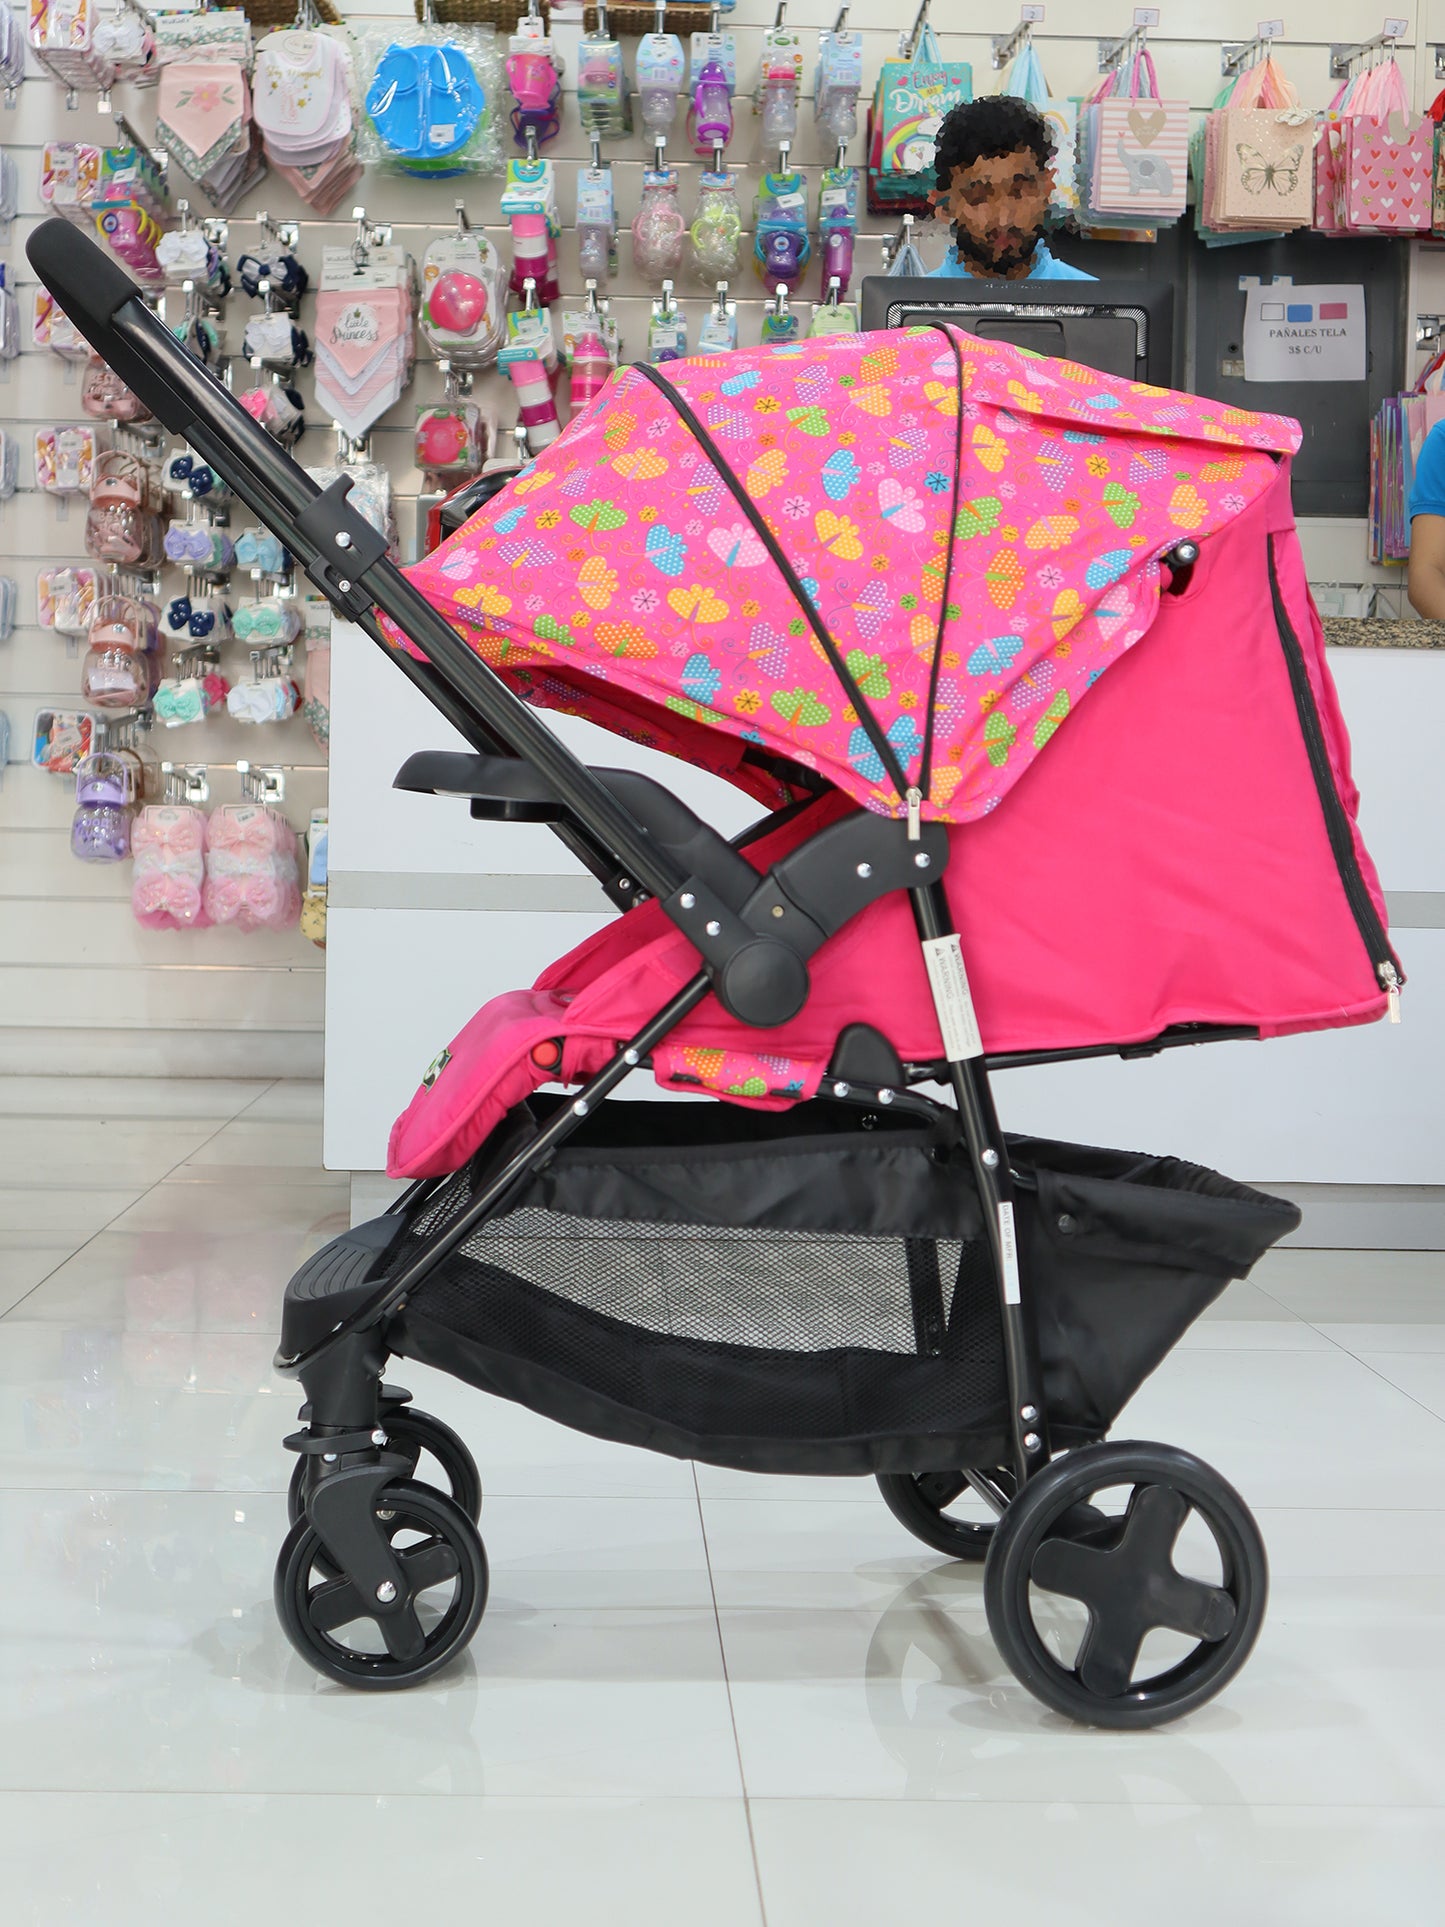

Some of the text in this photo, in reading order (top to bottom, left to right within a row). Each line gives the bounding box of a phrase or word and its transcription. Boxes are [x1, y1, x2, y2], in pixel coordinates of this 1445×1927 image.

[889, 88, 961, 113] Dream
[329, 327, 379, 344] Princess
[1269, 327, 1347, 338] PAÑALES TELA
[1288, 345, 1323, 354] 3$ C/U
[1002, 1204, 1010, 1224] DATE
[1004, 1227, 1011, 1239] OF
